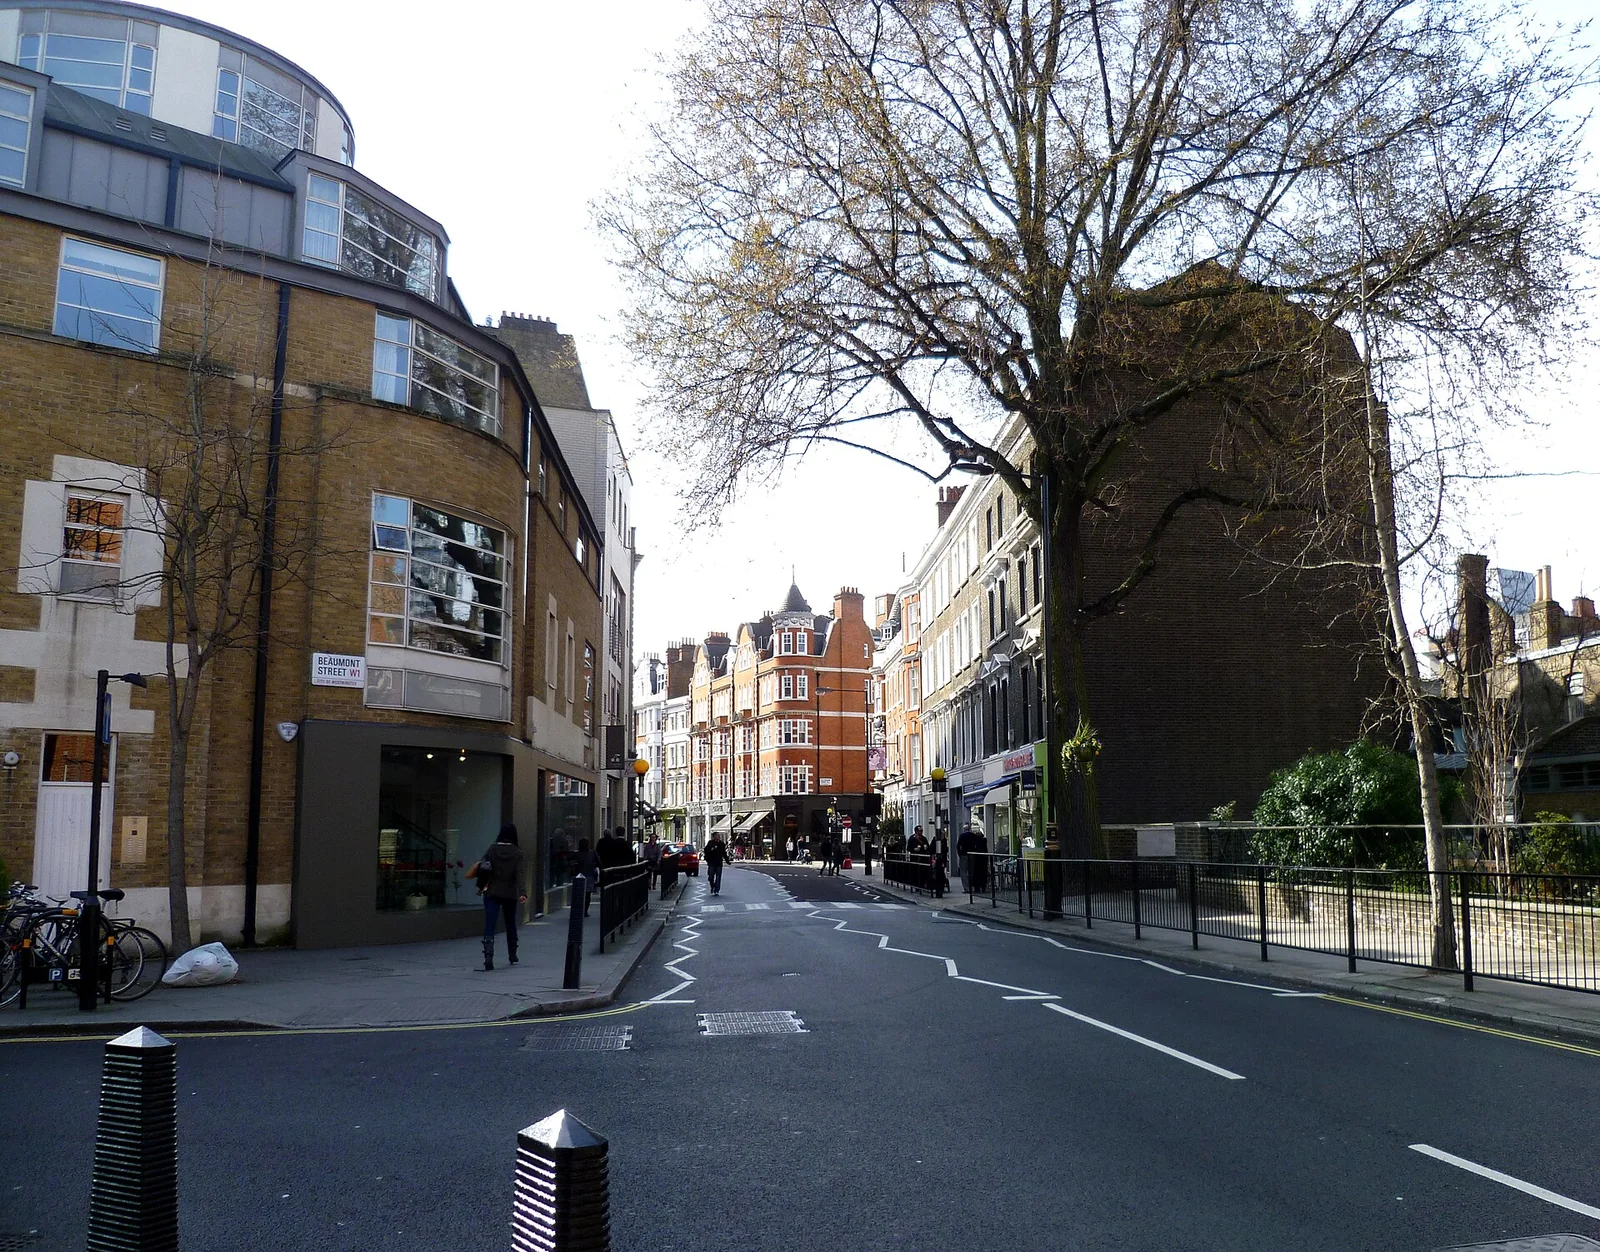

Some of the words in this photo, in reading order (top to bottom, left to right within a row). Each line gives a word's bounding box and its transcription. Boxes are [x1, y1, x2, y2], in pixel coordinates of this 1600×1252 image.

[318, 657, 361, 668] BEAUMONT
[317, 667, 347, 677] STREET
[349, 669, 361, 678] W1
[52, 970, 60, 980] P
